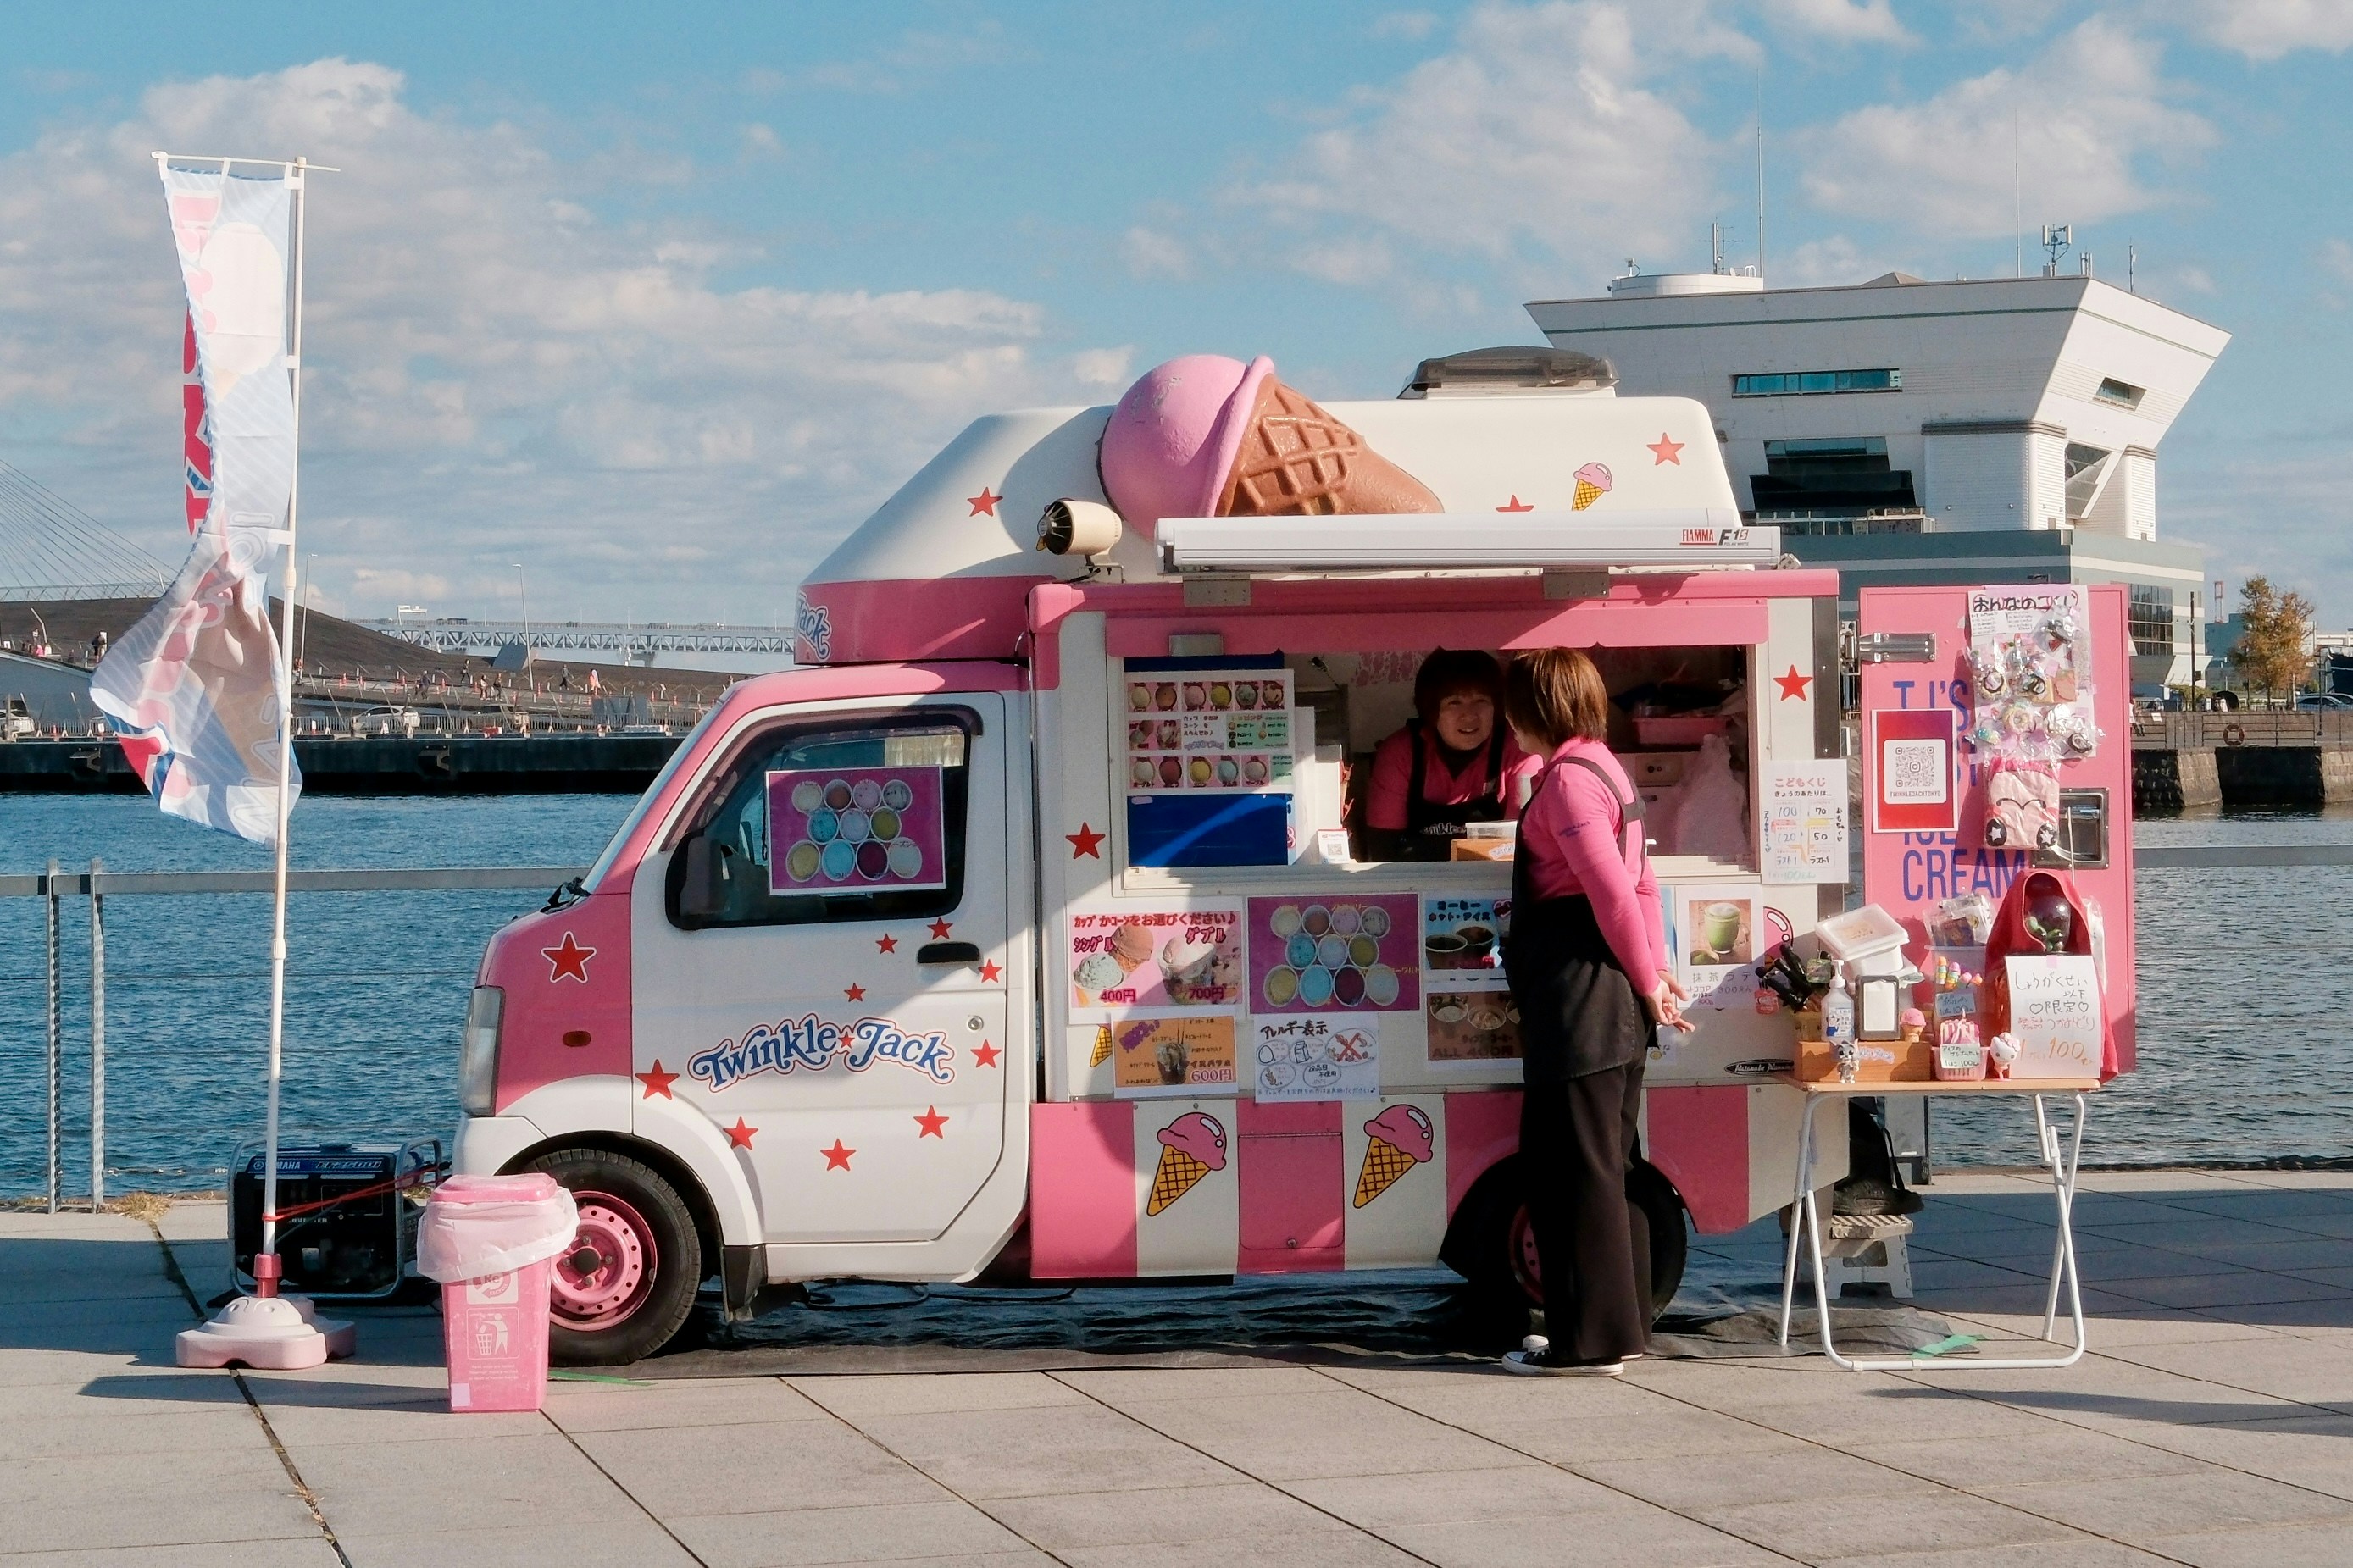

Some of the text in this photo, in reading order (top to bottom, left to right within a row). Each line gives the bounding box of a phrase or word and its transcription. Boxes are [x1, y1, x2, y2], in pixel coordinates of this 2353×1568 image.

[1682, 529, 1714, 542] FIAMMA
[1775, 778, 1826, 787] こどもくじ
[1778, 806, 1798, 818] 100
[1777, 833, 1796, 843] 120
[1813, 832, 1828, 840] 50
[1903, 848, 2025, 901] CREAM
[1437, 900, 1481, 911] コーヒー
[1185, 927, 1226, 943] ダブル
[1074, 935, 1116, 953] シングル
[2015, 971, 2088, 990] しょうがくせい
[1099, 989, 1136, 1003] 400円
[1189, 987, 1224, 1000] 700円
[2063, 989, 2085, 999] 以下
[1260, 1019, 1329, 1039] アレルギー表示
[692, 1019, 949, 1088] Twinkle Jack
[1190, 1068, 1233, 1083] 600円
